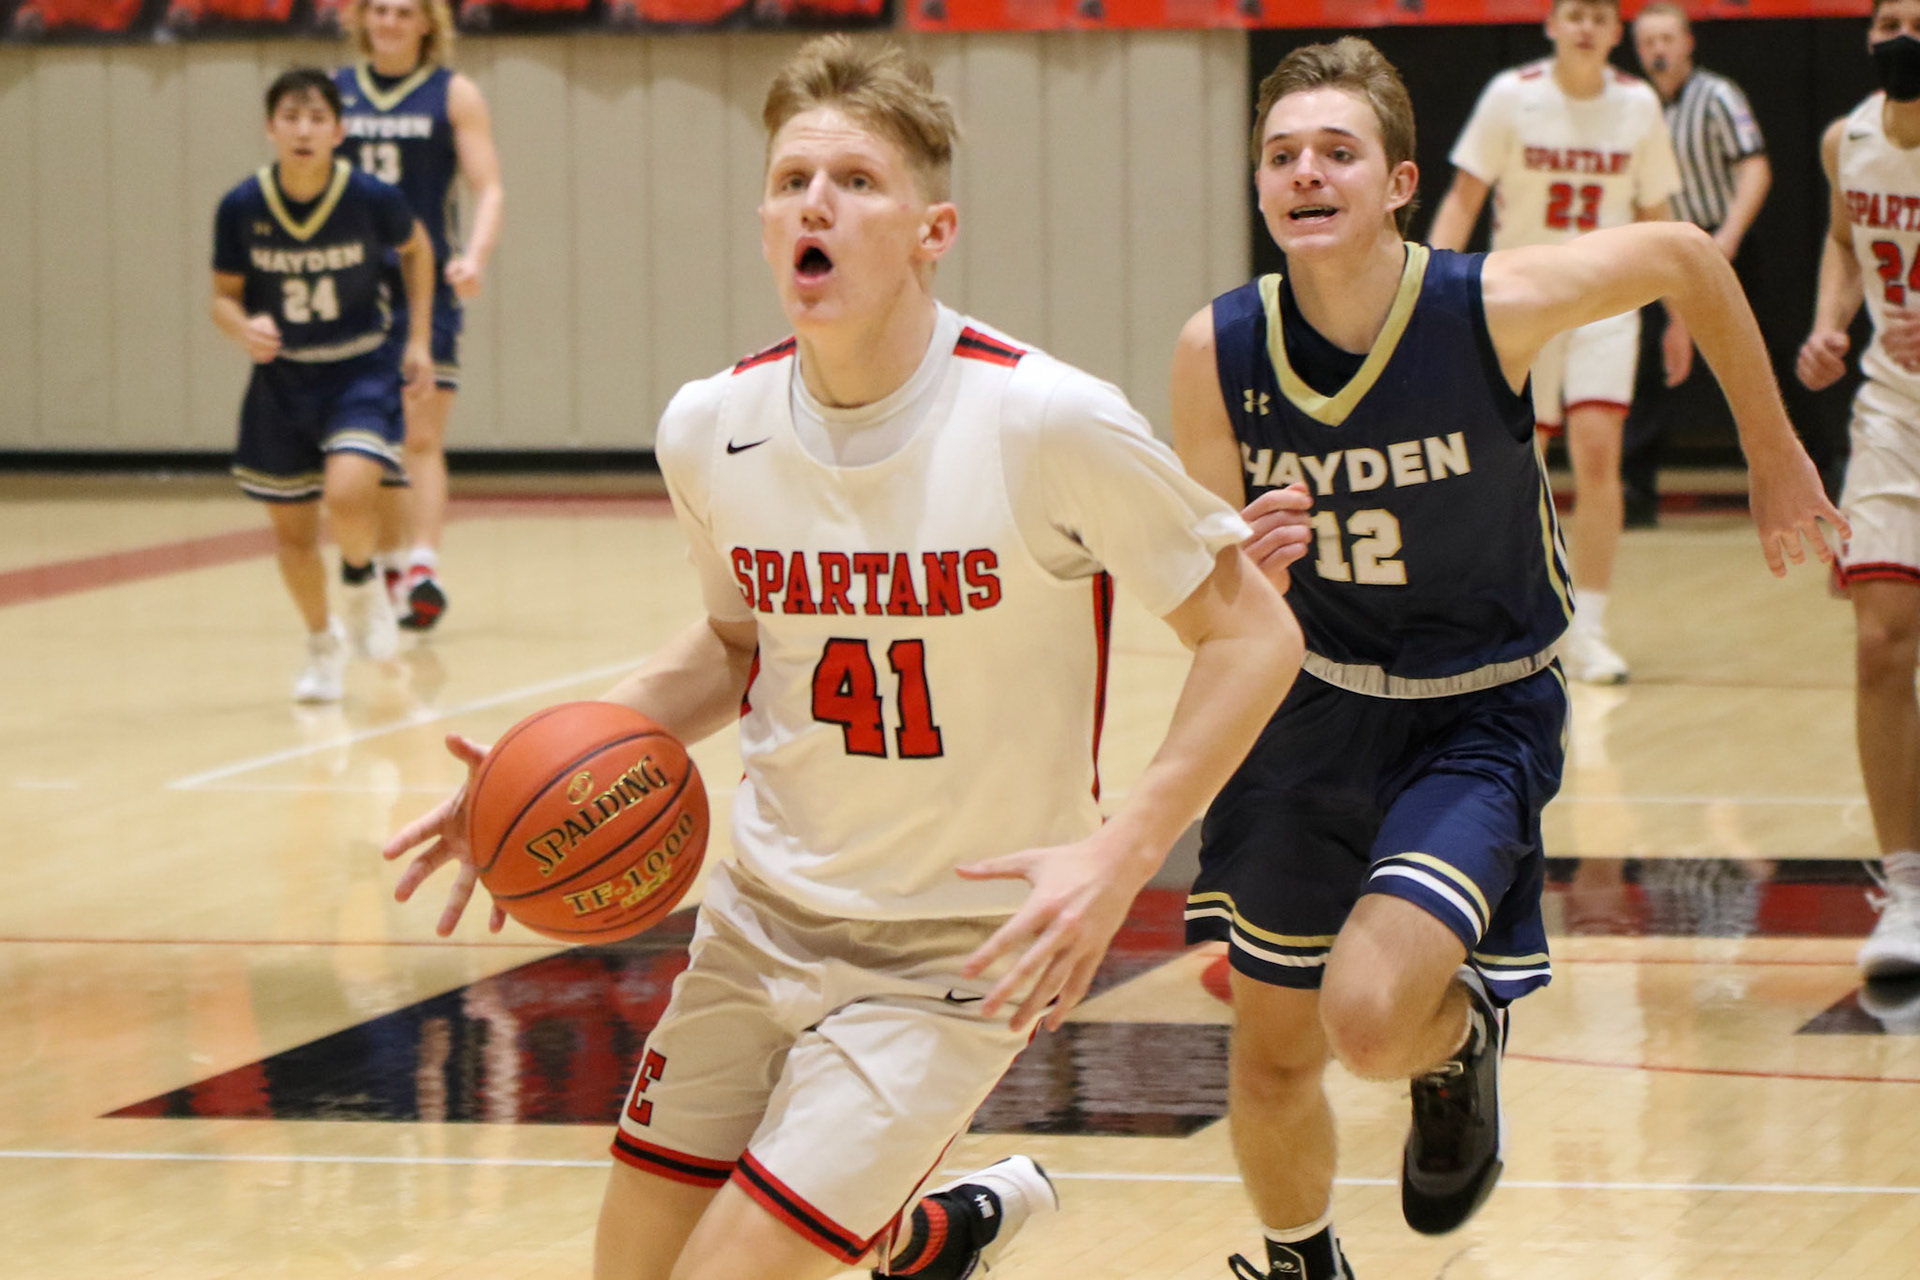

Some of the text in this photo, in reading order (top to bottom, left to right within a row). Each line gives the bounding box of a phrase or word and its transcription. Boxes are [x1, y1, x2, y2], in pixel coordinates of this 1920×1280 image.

[361, 143, 401, 184] 13
[1545, 182, 1604, 231] 23
[1845, 189, 1920, 231] SPART
[251, 243, 364, 272] HAYDEN
[282, 275, 339, 322] 24
[1241, 431, 1471, 496] HAYDEN
[1310, 508, 1408, 585] 12
[731, 547, 1002, 616] SPARTANS
[811, 637, 944, 759] 41
[525, 755, 668, 876] SPALDING
[563, 812, 693, 914] TF-1000
[627, 1048, 667, 1127] E
